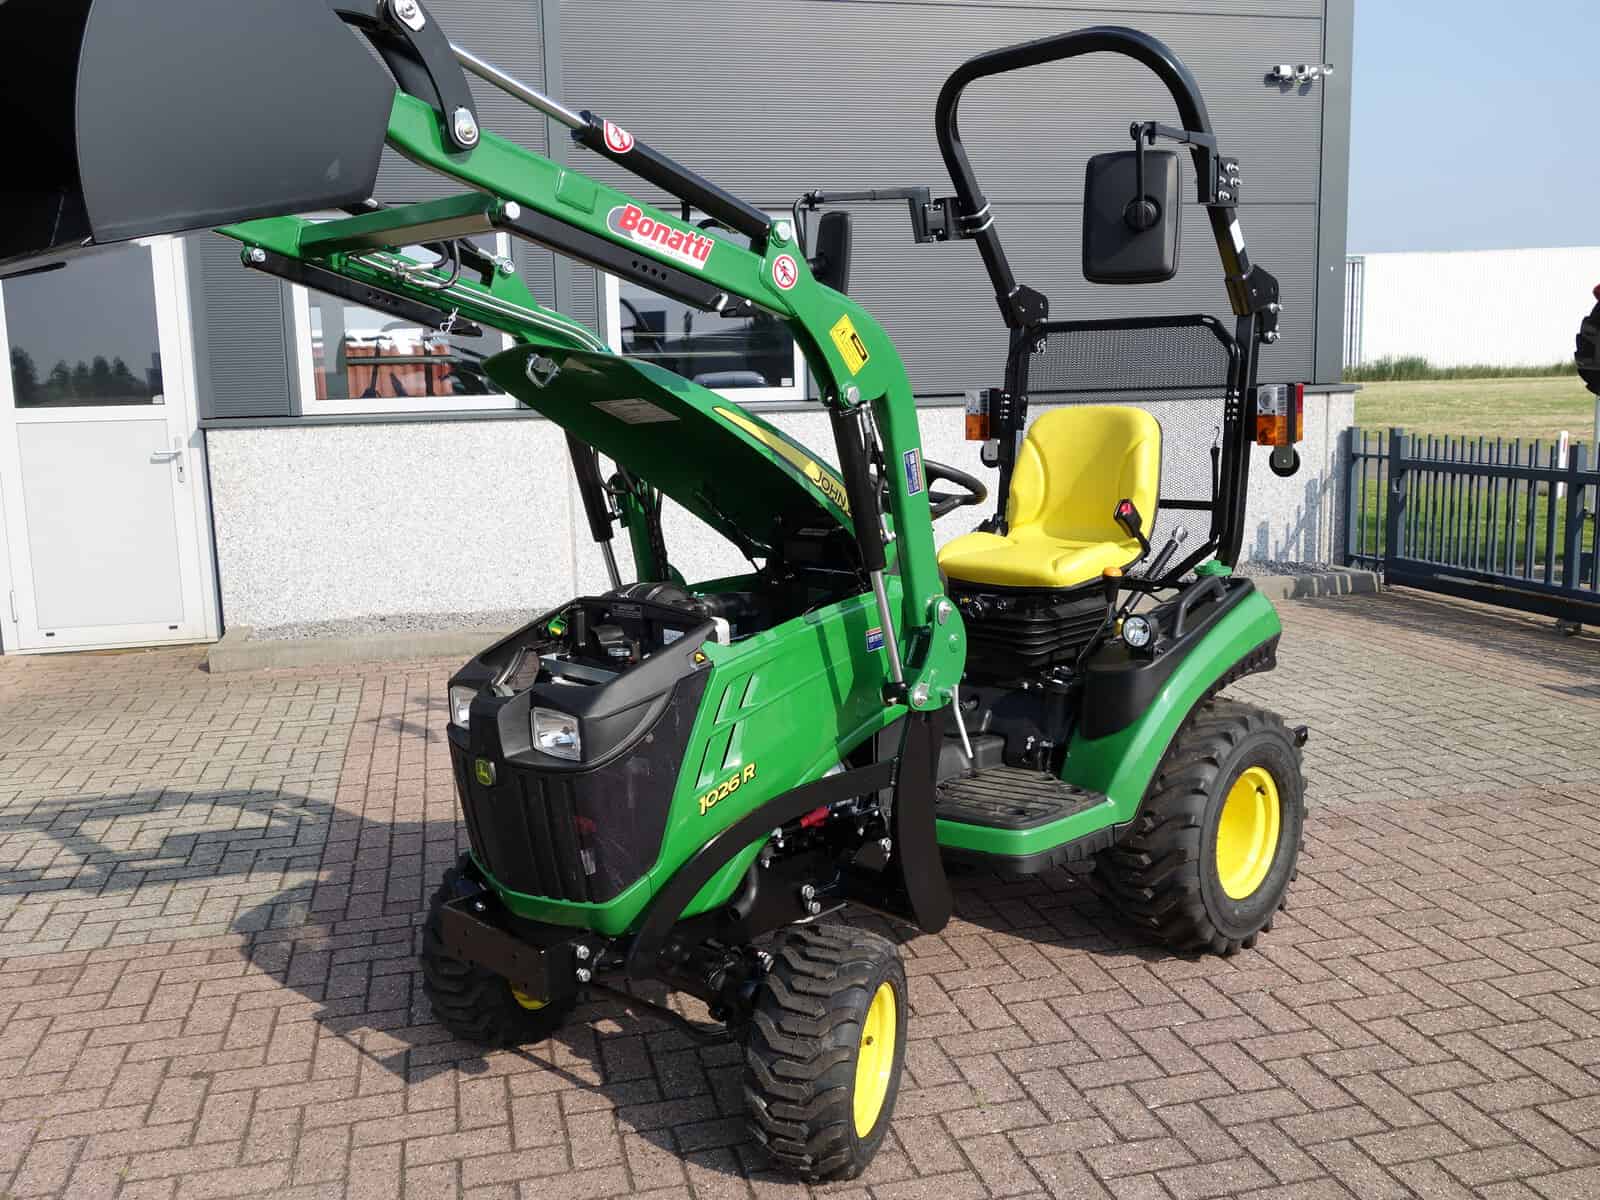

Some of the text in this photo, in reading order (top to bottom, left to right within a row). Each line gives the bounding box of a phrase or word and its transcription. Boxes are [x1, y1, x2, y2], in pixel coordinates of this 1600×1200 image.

[619, 204, 713, 262] Bonatti
[814, 471, 848, 509] JOHN
[699, 762, 756, 816] 1026 R
